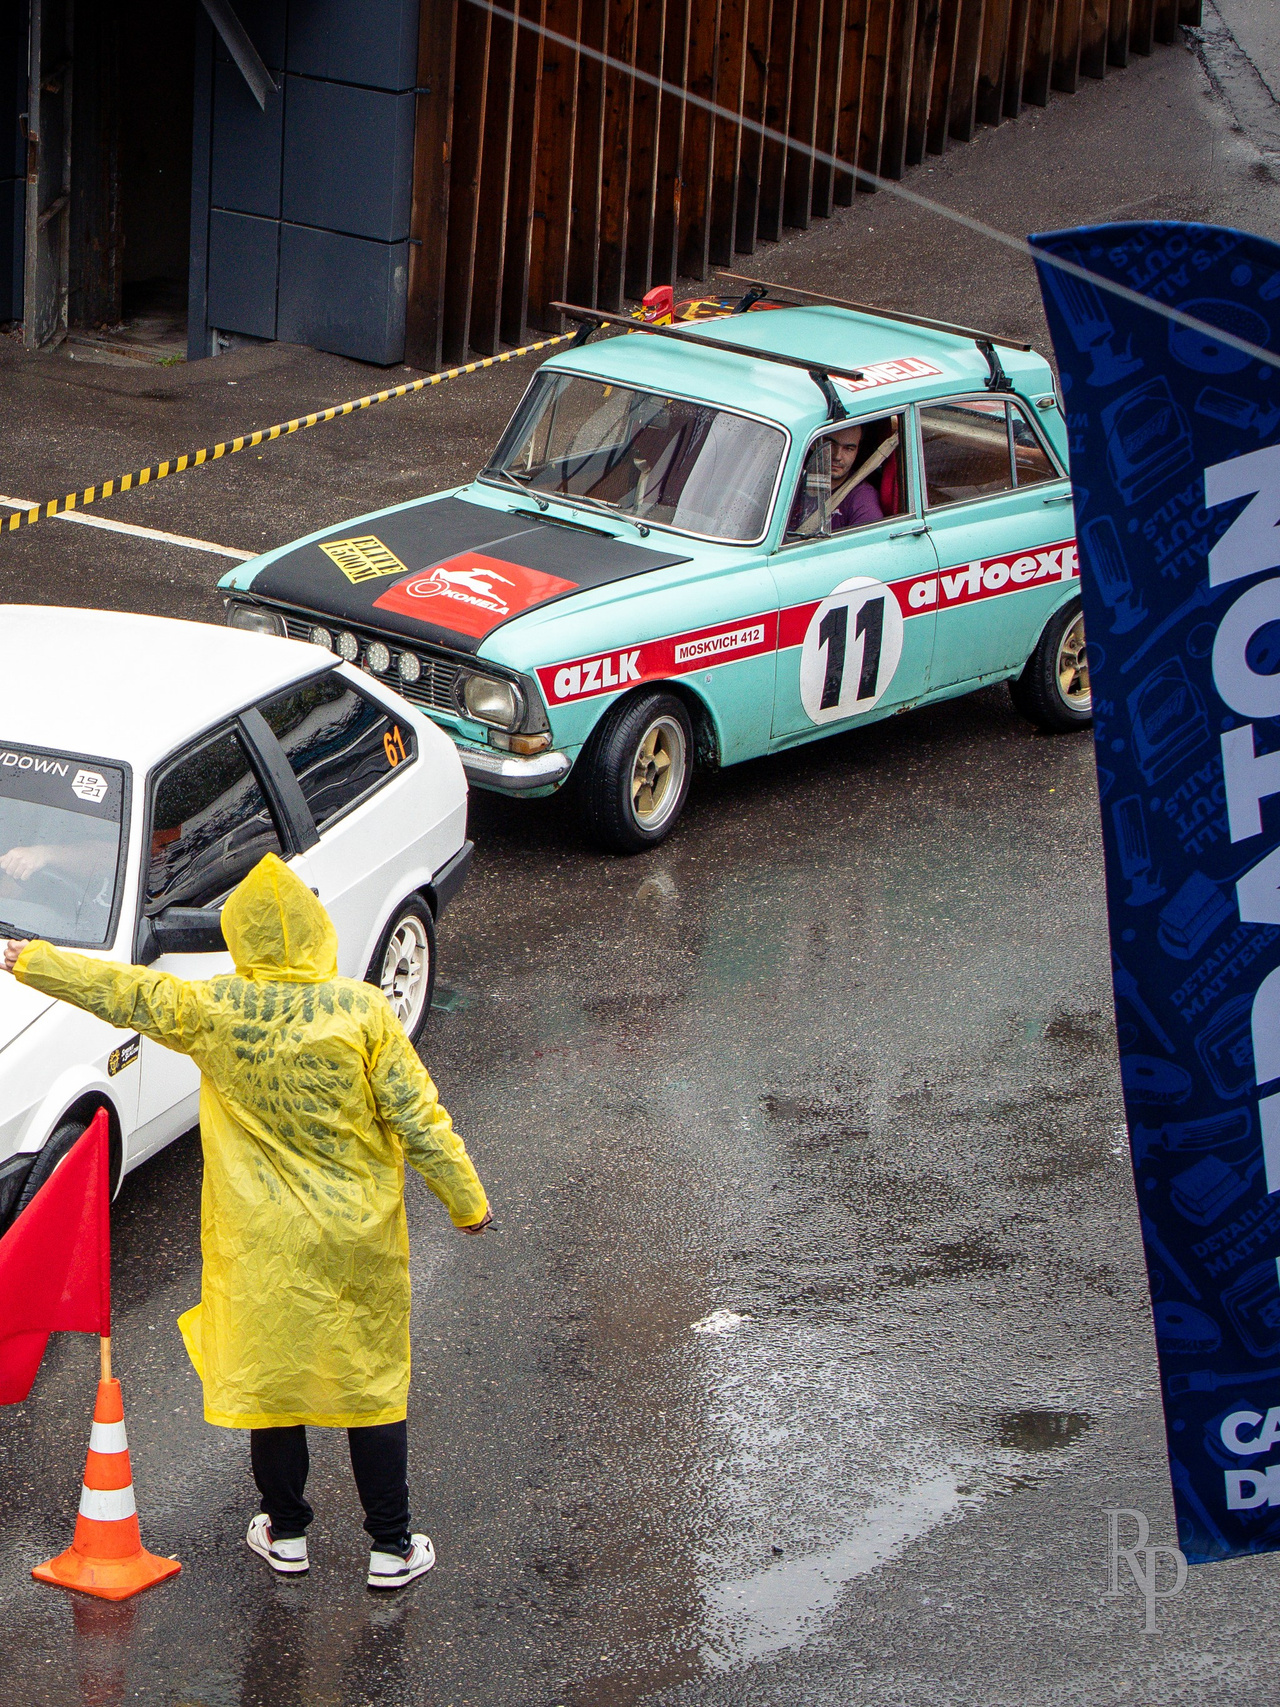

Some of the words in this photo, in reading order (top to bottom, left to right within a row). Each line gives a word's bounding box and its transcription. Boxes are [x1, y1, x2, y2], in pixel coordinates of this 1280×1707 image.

[352, 537, 403, 575] ELITE
[440, 589, 510, 616] KONELA
[679, 634, 738, 659] MOSKVICH
[740, 629, 760, 644] 412
[818, 595, 886, 711] 11
[383, 724, 407, 768] 61
[76, 774, 99, 785] 19
[81, 785, 102, 798] 21
